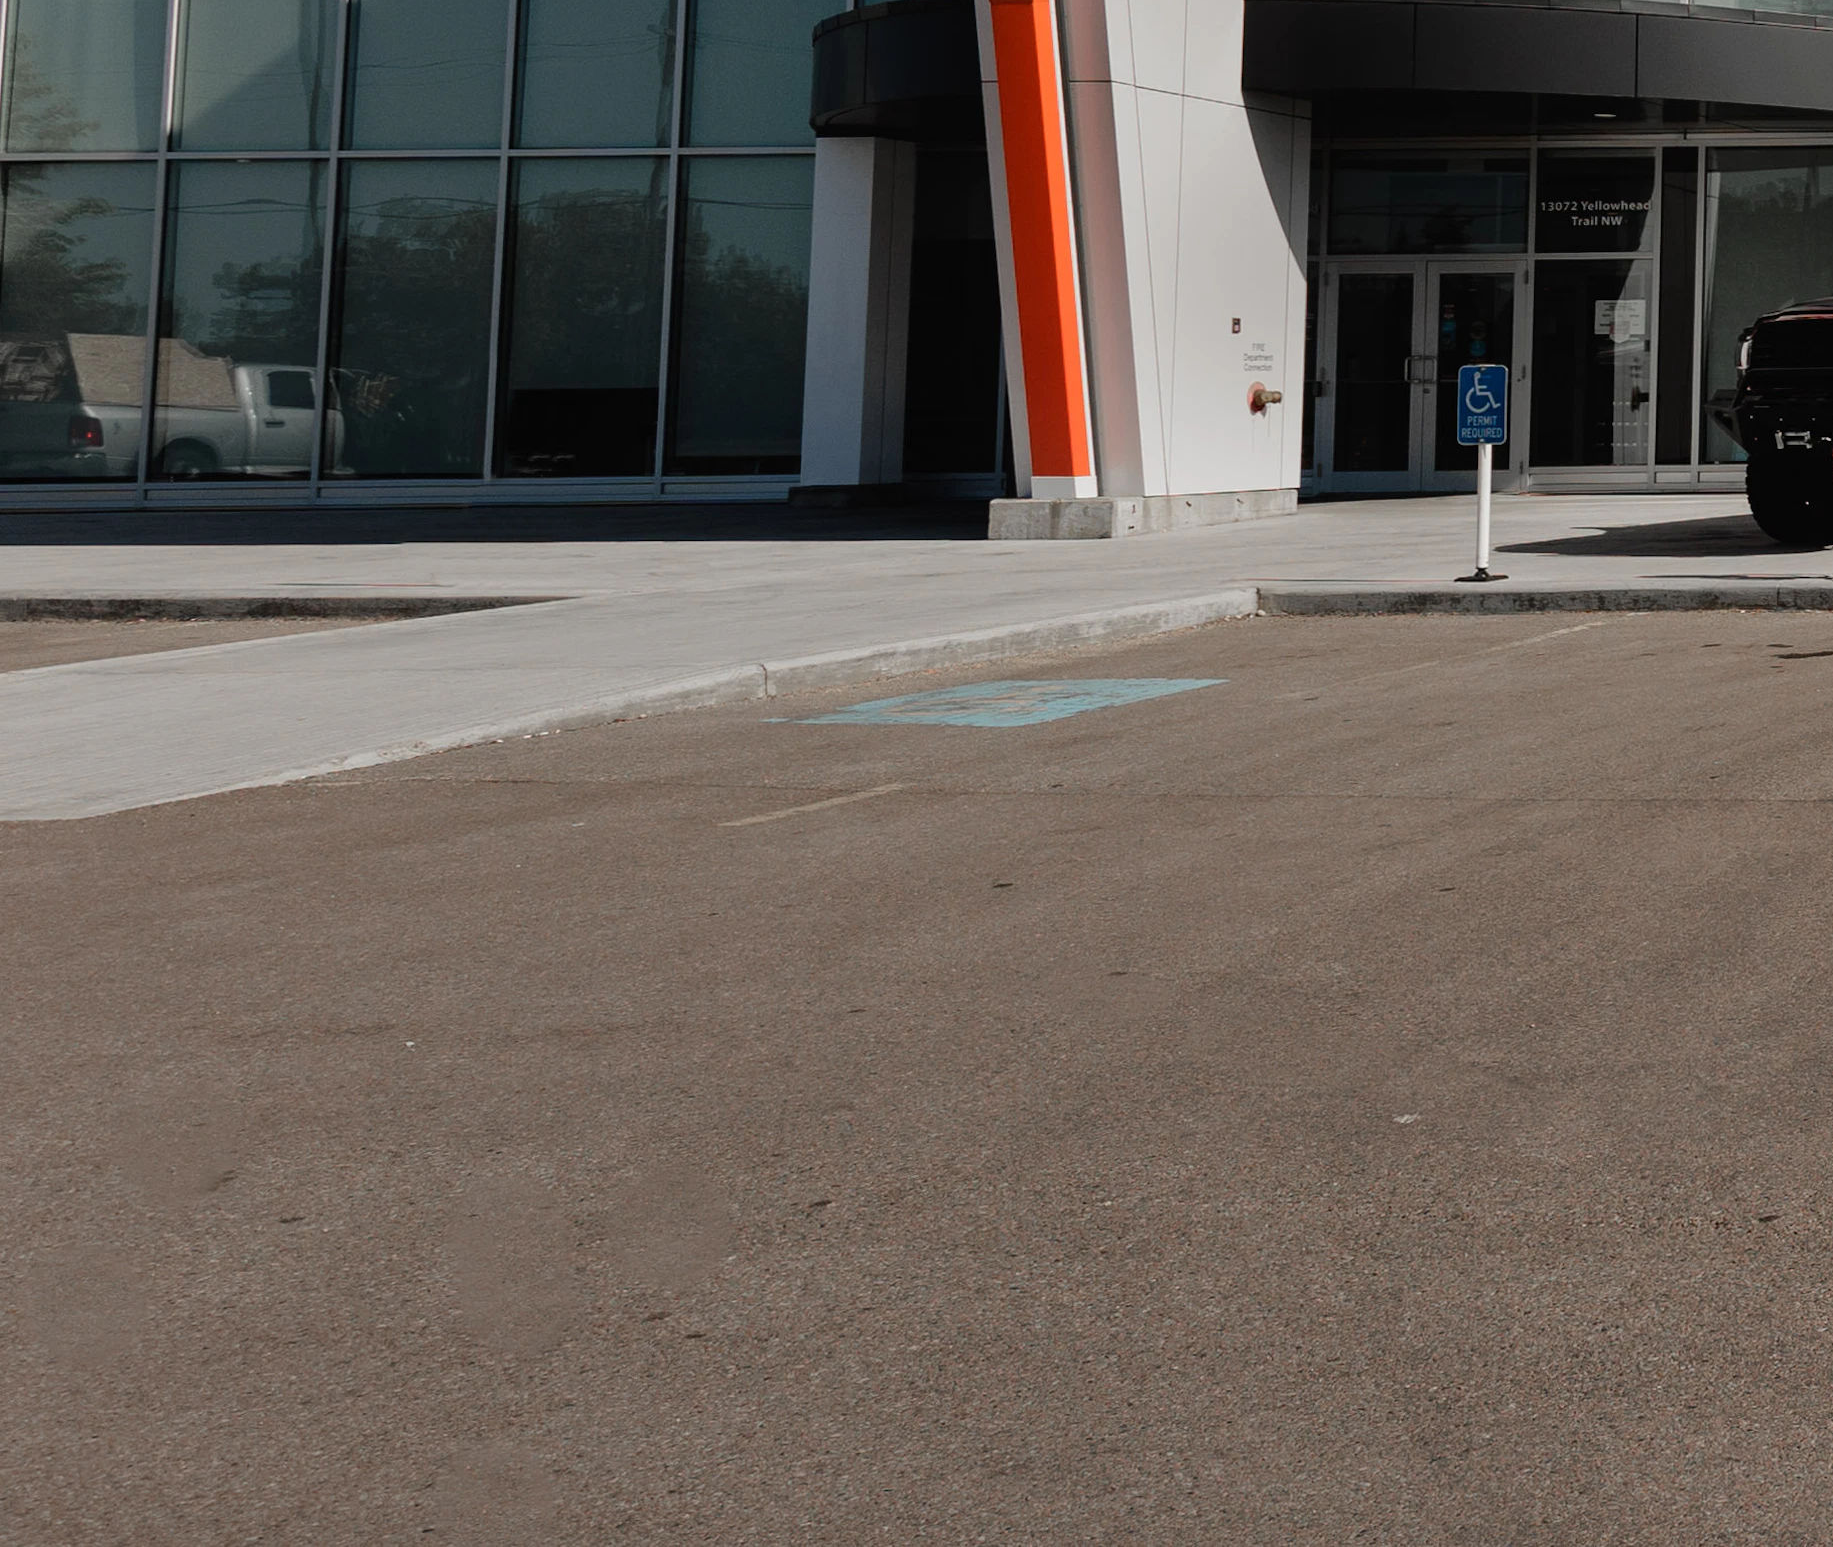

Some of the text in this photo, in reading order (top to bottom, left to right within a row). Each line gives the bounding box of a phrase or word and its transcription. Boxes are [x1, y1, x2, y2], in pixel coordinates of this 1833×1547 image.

[1541, 200, 1652, 212] 13072 Yellowhead
[1571, 216, 1623, 226] Trail NW
[1467, 415, 1498, 426] PERMIT
[1461, 427, 1503, 438] REQUIRED
